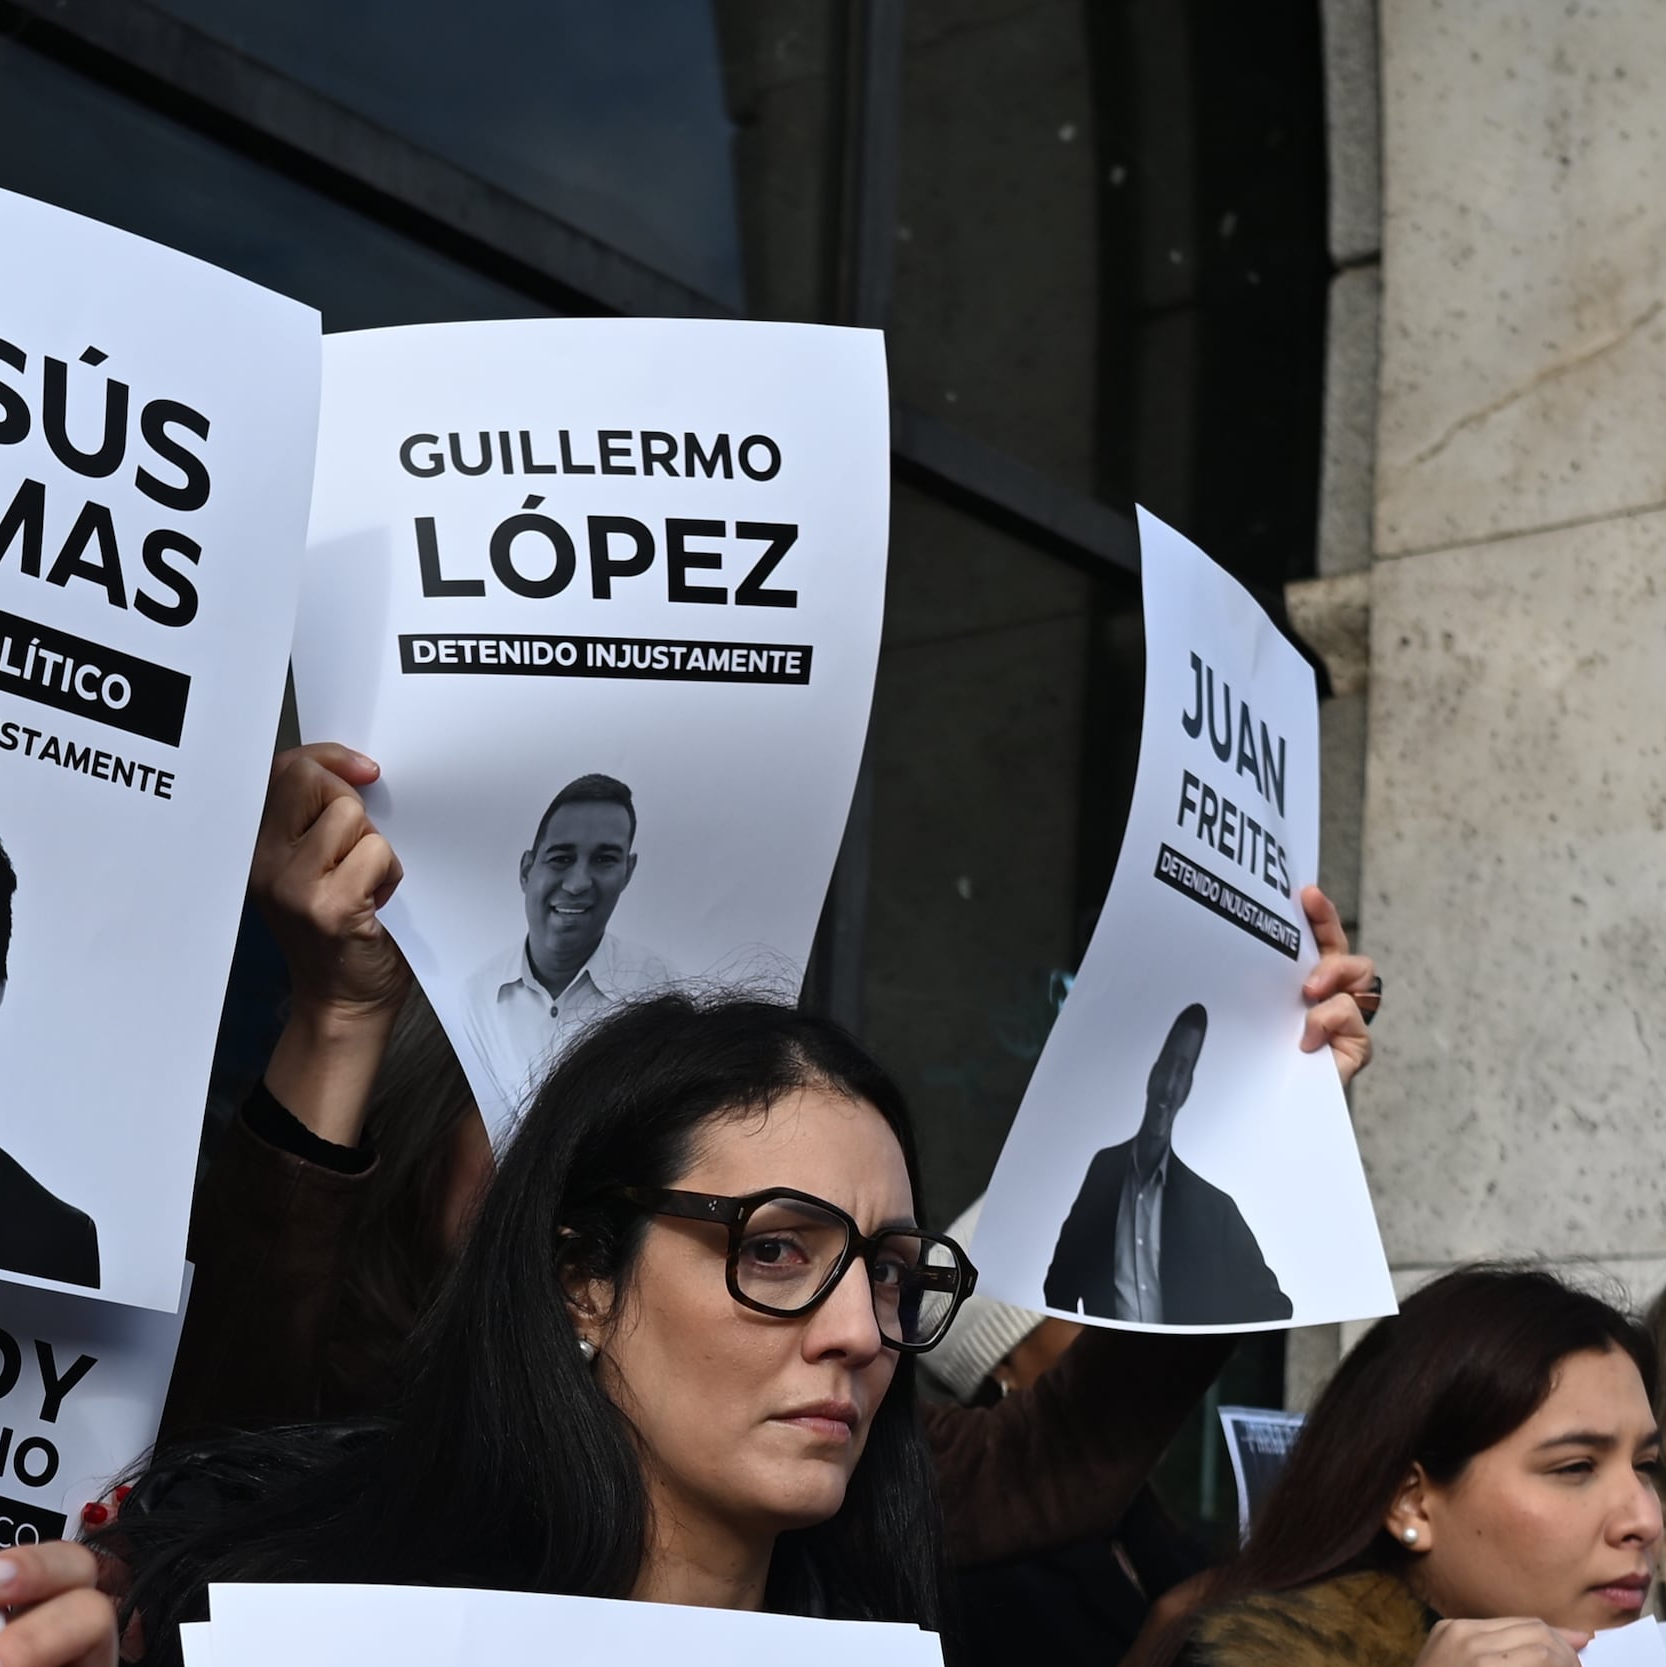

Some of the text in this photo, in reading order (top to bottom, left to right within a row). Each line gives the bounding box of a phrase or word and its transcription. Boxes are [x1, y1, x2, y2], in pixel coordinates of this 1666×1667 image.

[399, 429, 782, 483] GUILLERMO
[414, 494, 799, 609] LÓPEZ
[412, 640, 802, 675] DETENIDO INJUSTAMENTE
[1180, 650, 1287, 819] JUAN
[1177, 769, 1292, 901] FREITES
[1159, 850, 1298, 953] DETENIDO INJUSTAMENTE
